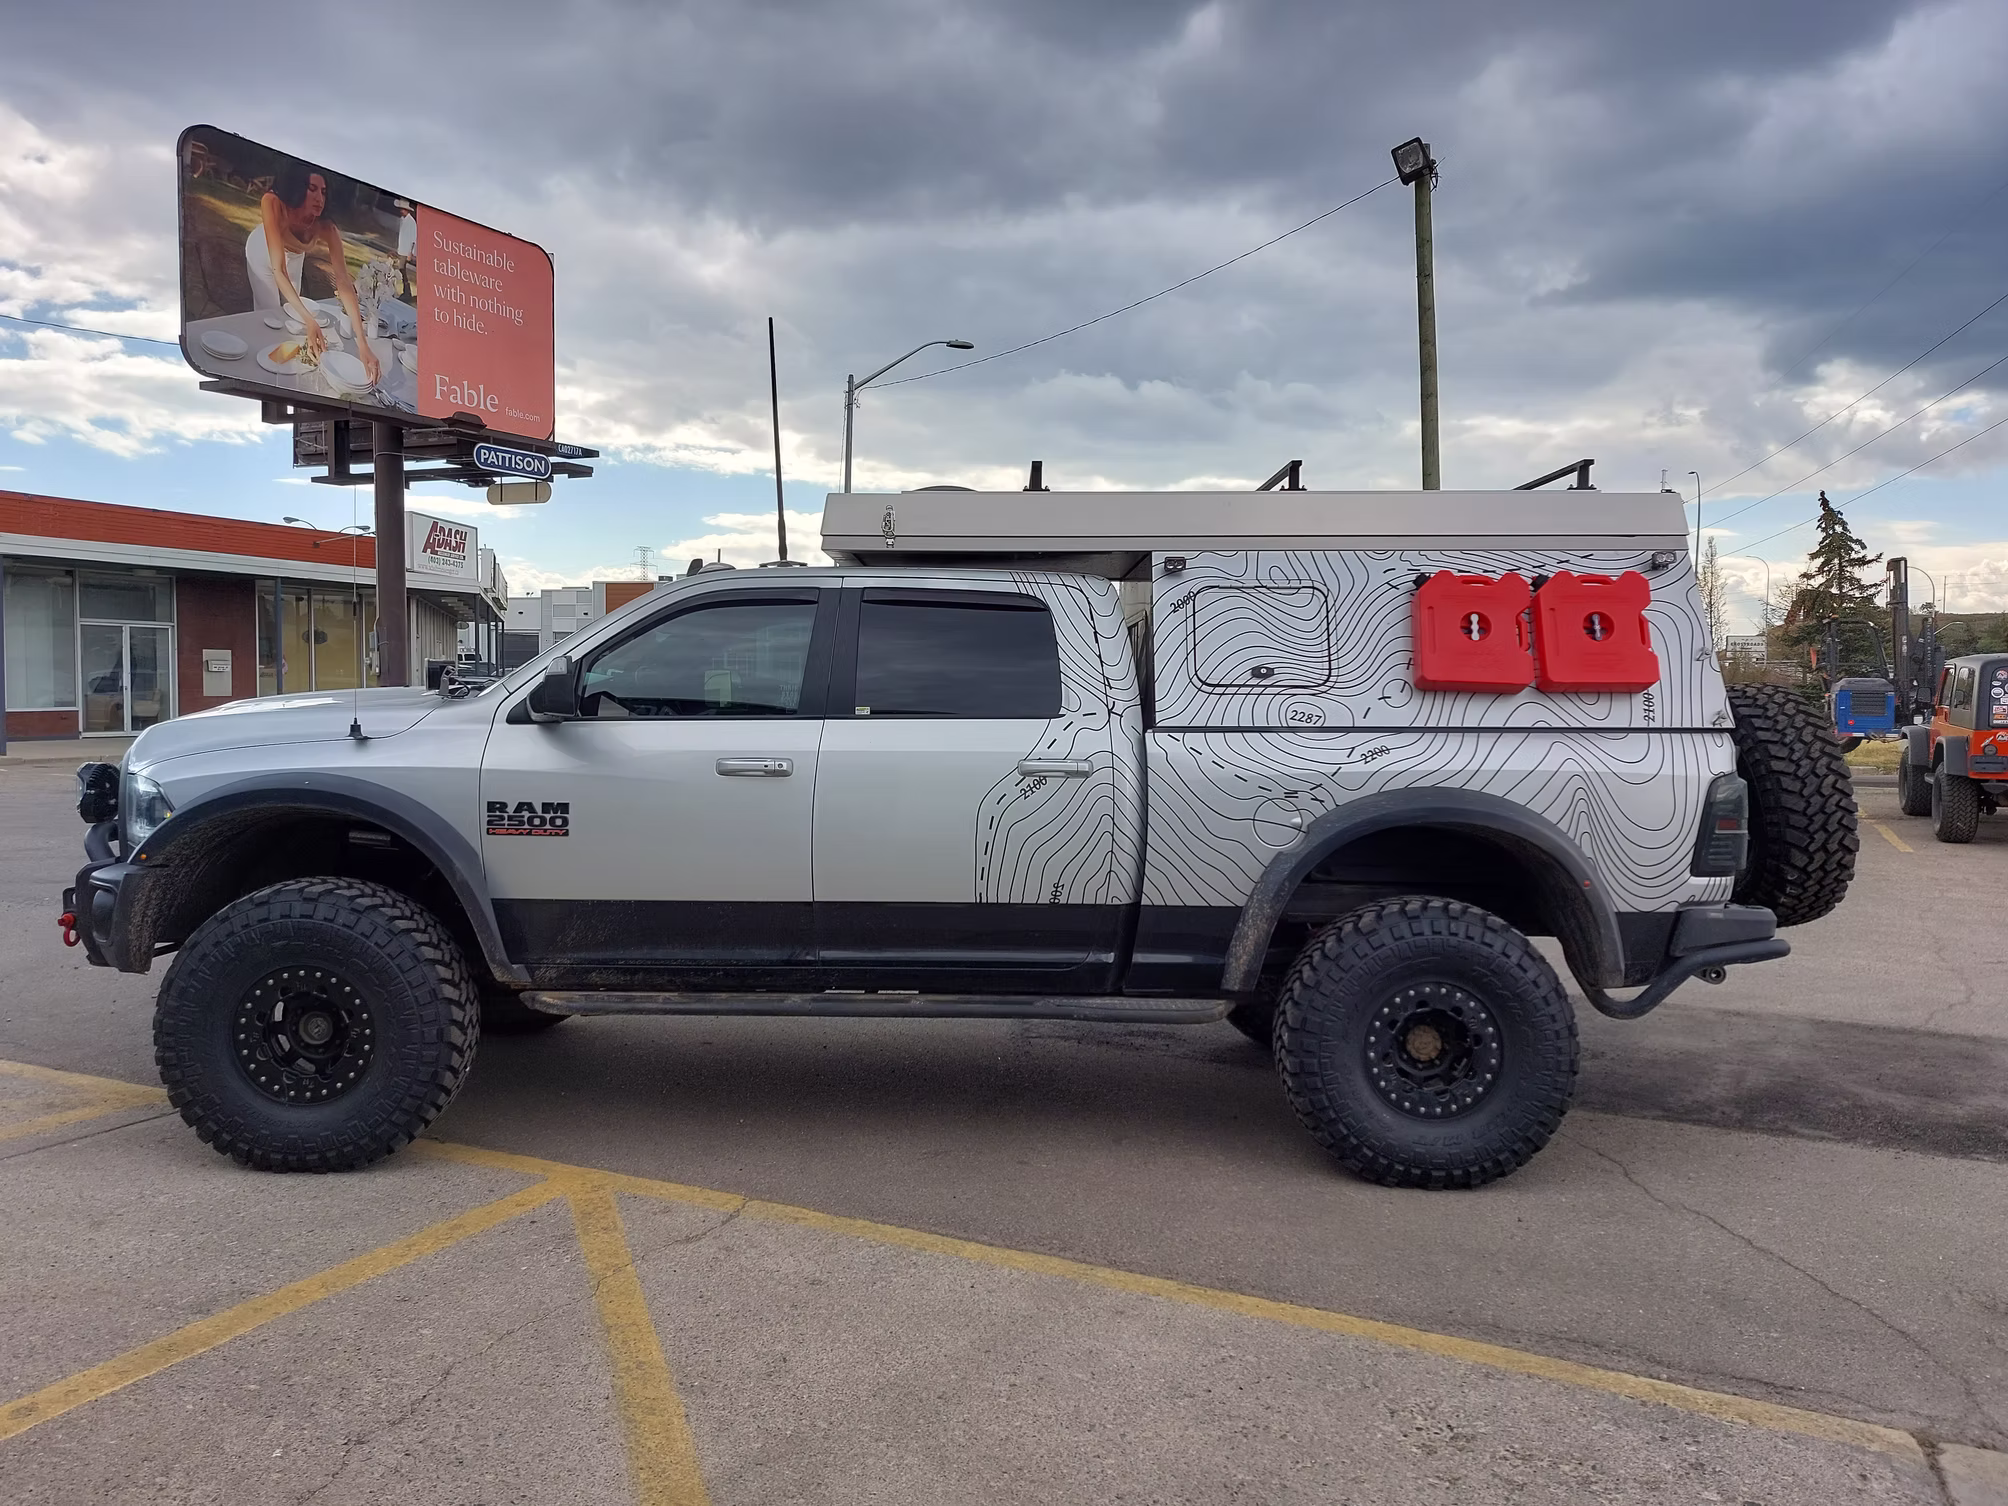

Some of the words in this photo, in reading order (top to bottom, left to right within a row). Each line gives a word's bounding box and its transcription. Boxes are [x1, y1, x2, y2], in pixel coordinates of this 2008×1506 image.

[433, 230, 515, 273] Sustainable
[433, 258, 503, 292] tableware
[433, 283, 466, 305] with
[470, 293, 524, 326] nothing
[434, 307, 449, 324] to
[453, 310, 488, 335] hide.
[434, 374, 499, 413] Fable
[505, 406, 541, 423] fable.com
[480, 450, 545, 474] PATTISON
[1170, 591, 1196, 613] 2000
[1289, 710, 1322, 726] 2287
[1643, 692, 1655, 723] 2100
[1360, 745, 1391, 765] 2200
[1019, 776, 1048, 801] 2100
[487, 801, 570, 815] RAM
[487, 814, 570, 828] 2500
[489, 828, 529, 836] HEAVY
